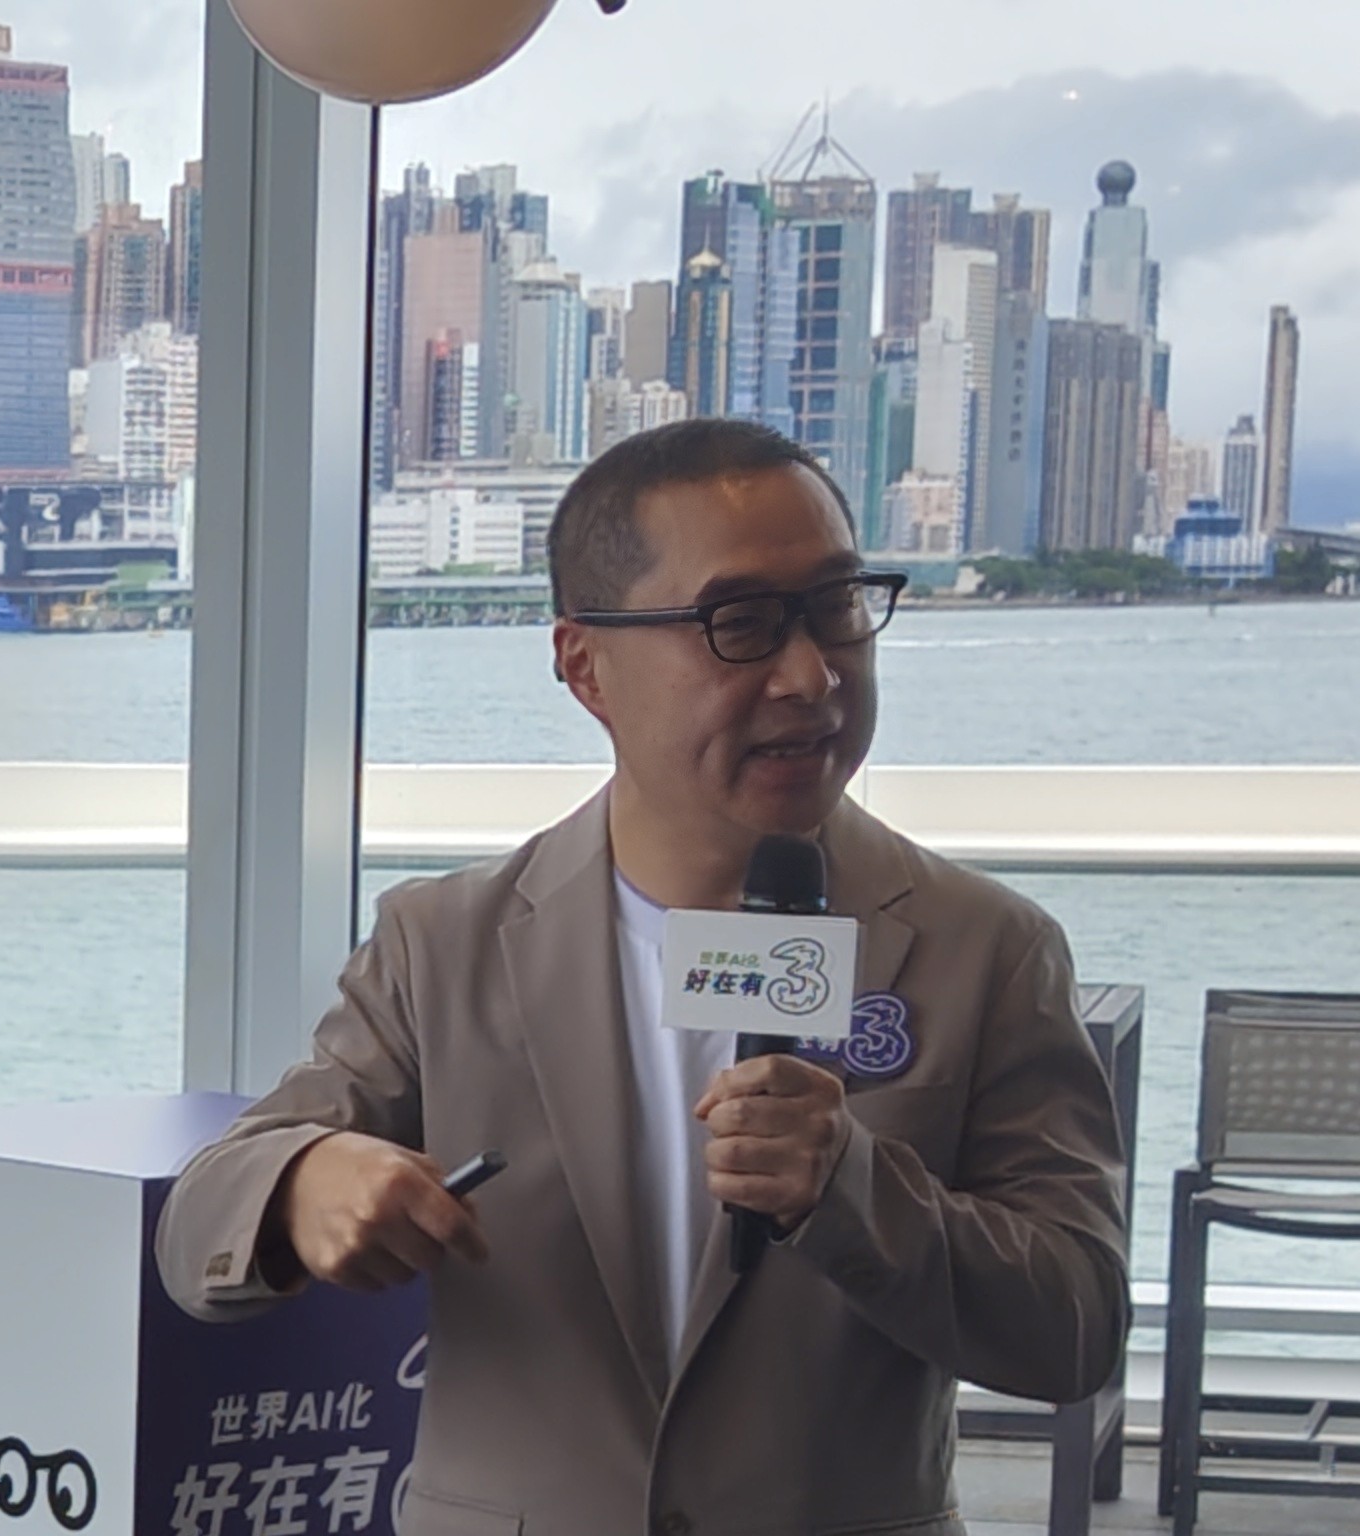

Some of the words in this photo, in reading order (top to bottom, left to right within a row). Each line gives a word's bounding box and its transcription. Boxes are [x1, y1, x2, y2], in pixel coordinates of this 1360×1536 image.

[683, 968, 768, 998] 好在有
[210, 1381, 376, 1447] 世界AI化
